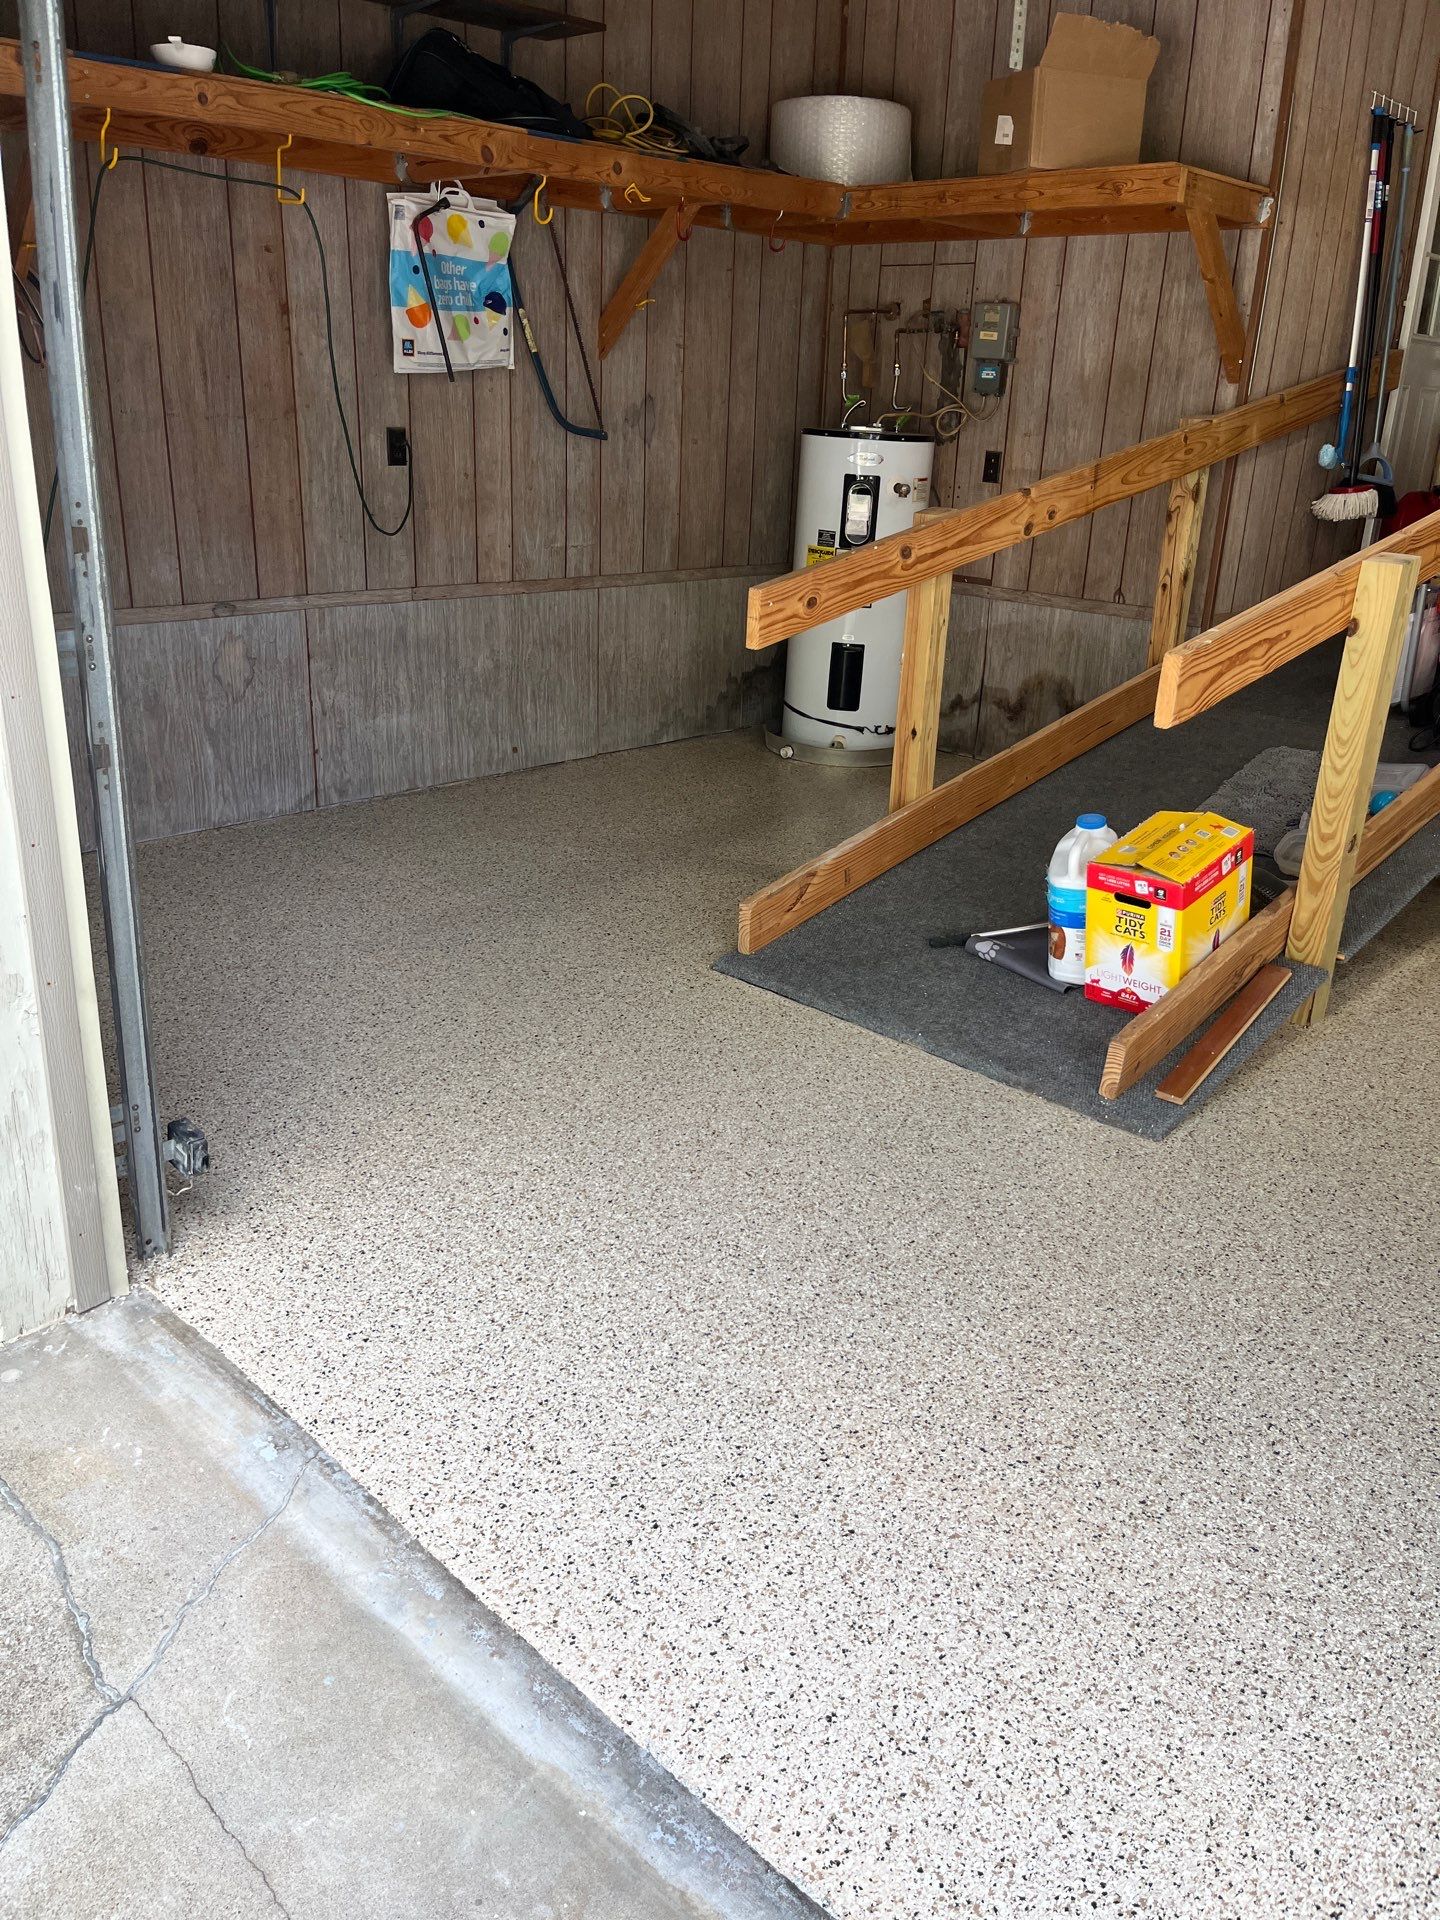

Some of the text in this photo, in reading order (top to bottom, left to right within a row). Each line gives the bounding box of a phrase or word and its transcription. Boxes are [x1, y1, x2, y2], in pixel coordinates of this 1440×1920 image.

[441, 261, 467, 276] Other
[434, 275, 477, 294] bags have
[438, 294, 453, 306] zero
[1211, 899, 1225, 915] TIDY
[1122, 910, 1145, 920] PURINA
[1210, 907, 1225, 925] CATS
[1116, 916, 1145, 929] TIDY
[1115, 925, 1145, 939] CATS
[1160, 928, 1171, 937] 21
[1097, 968, 1162, 994] LIGHTWEIGHT
